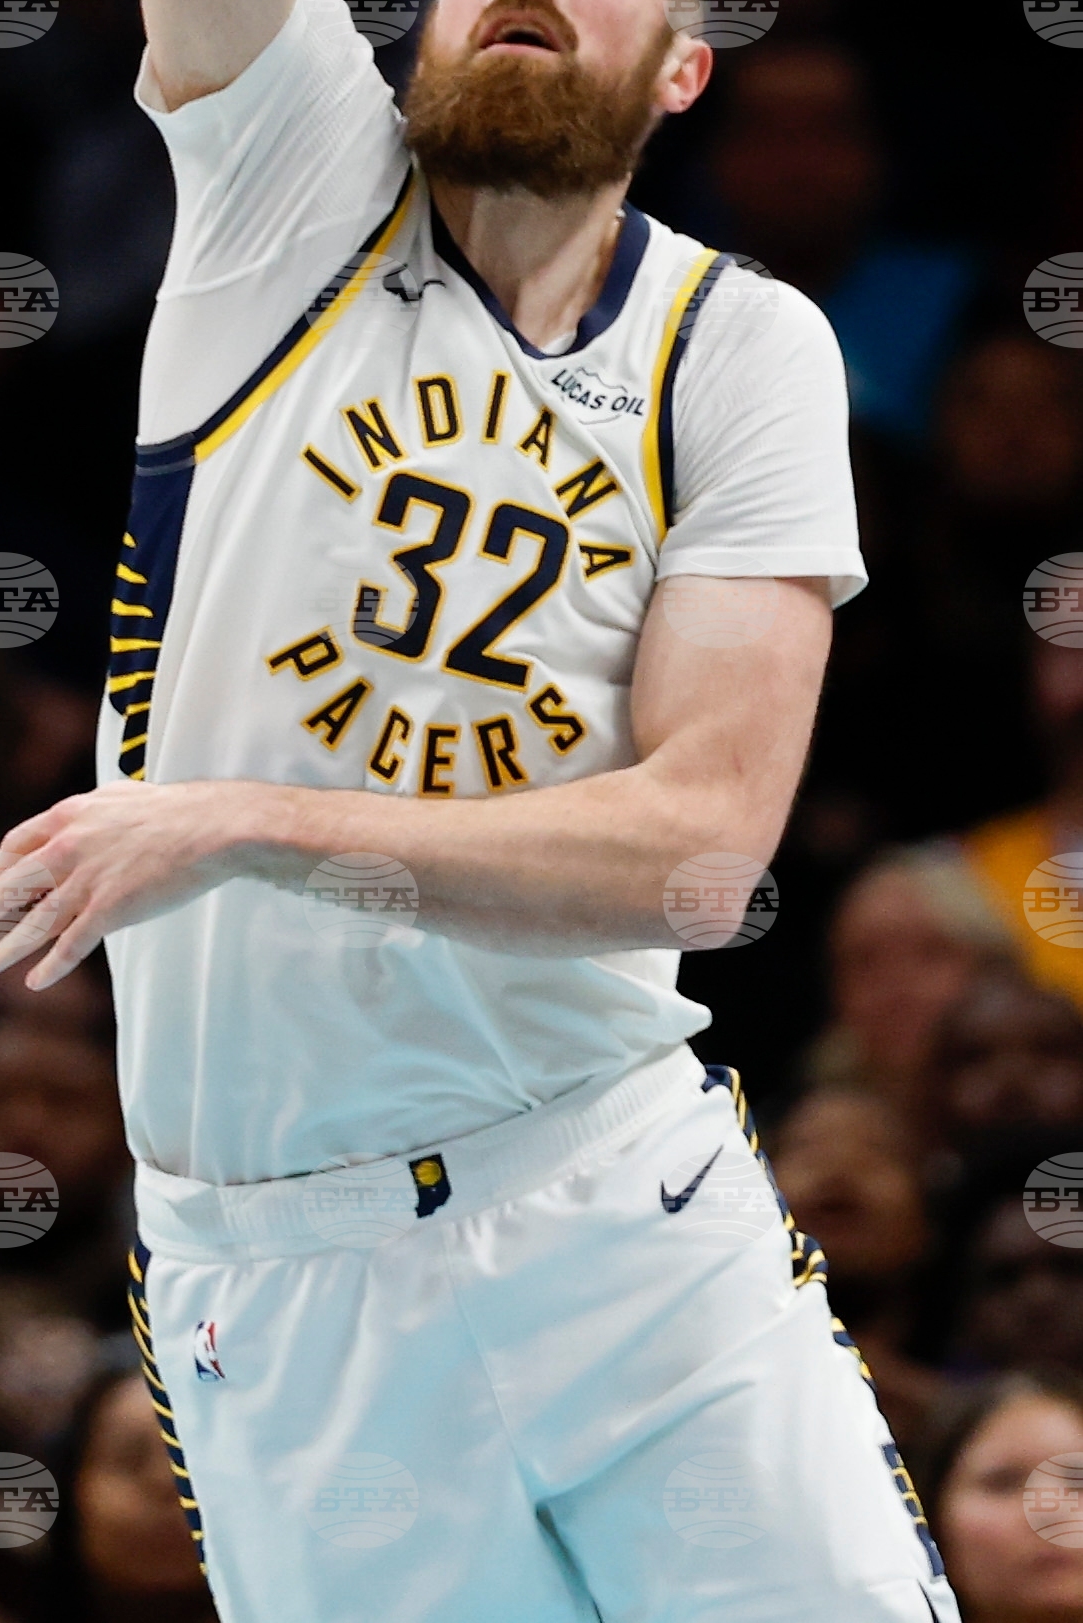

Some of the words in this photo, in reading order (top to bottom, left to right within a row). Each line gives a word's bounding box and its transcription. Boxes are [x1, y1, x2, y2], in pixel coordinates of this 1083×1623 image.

[300, 372, 634, 583] INDIANA
[551, 368, 607, 410] LUCAS
[611, 396, 645, 416] OIL
[350, 470, 572, 693] 32
[266, 625, 588, 797] PACERS
